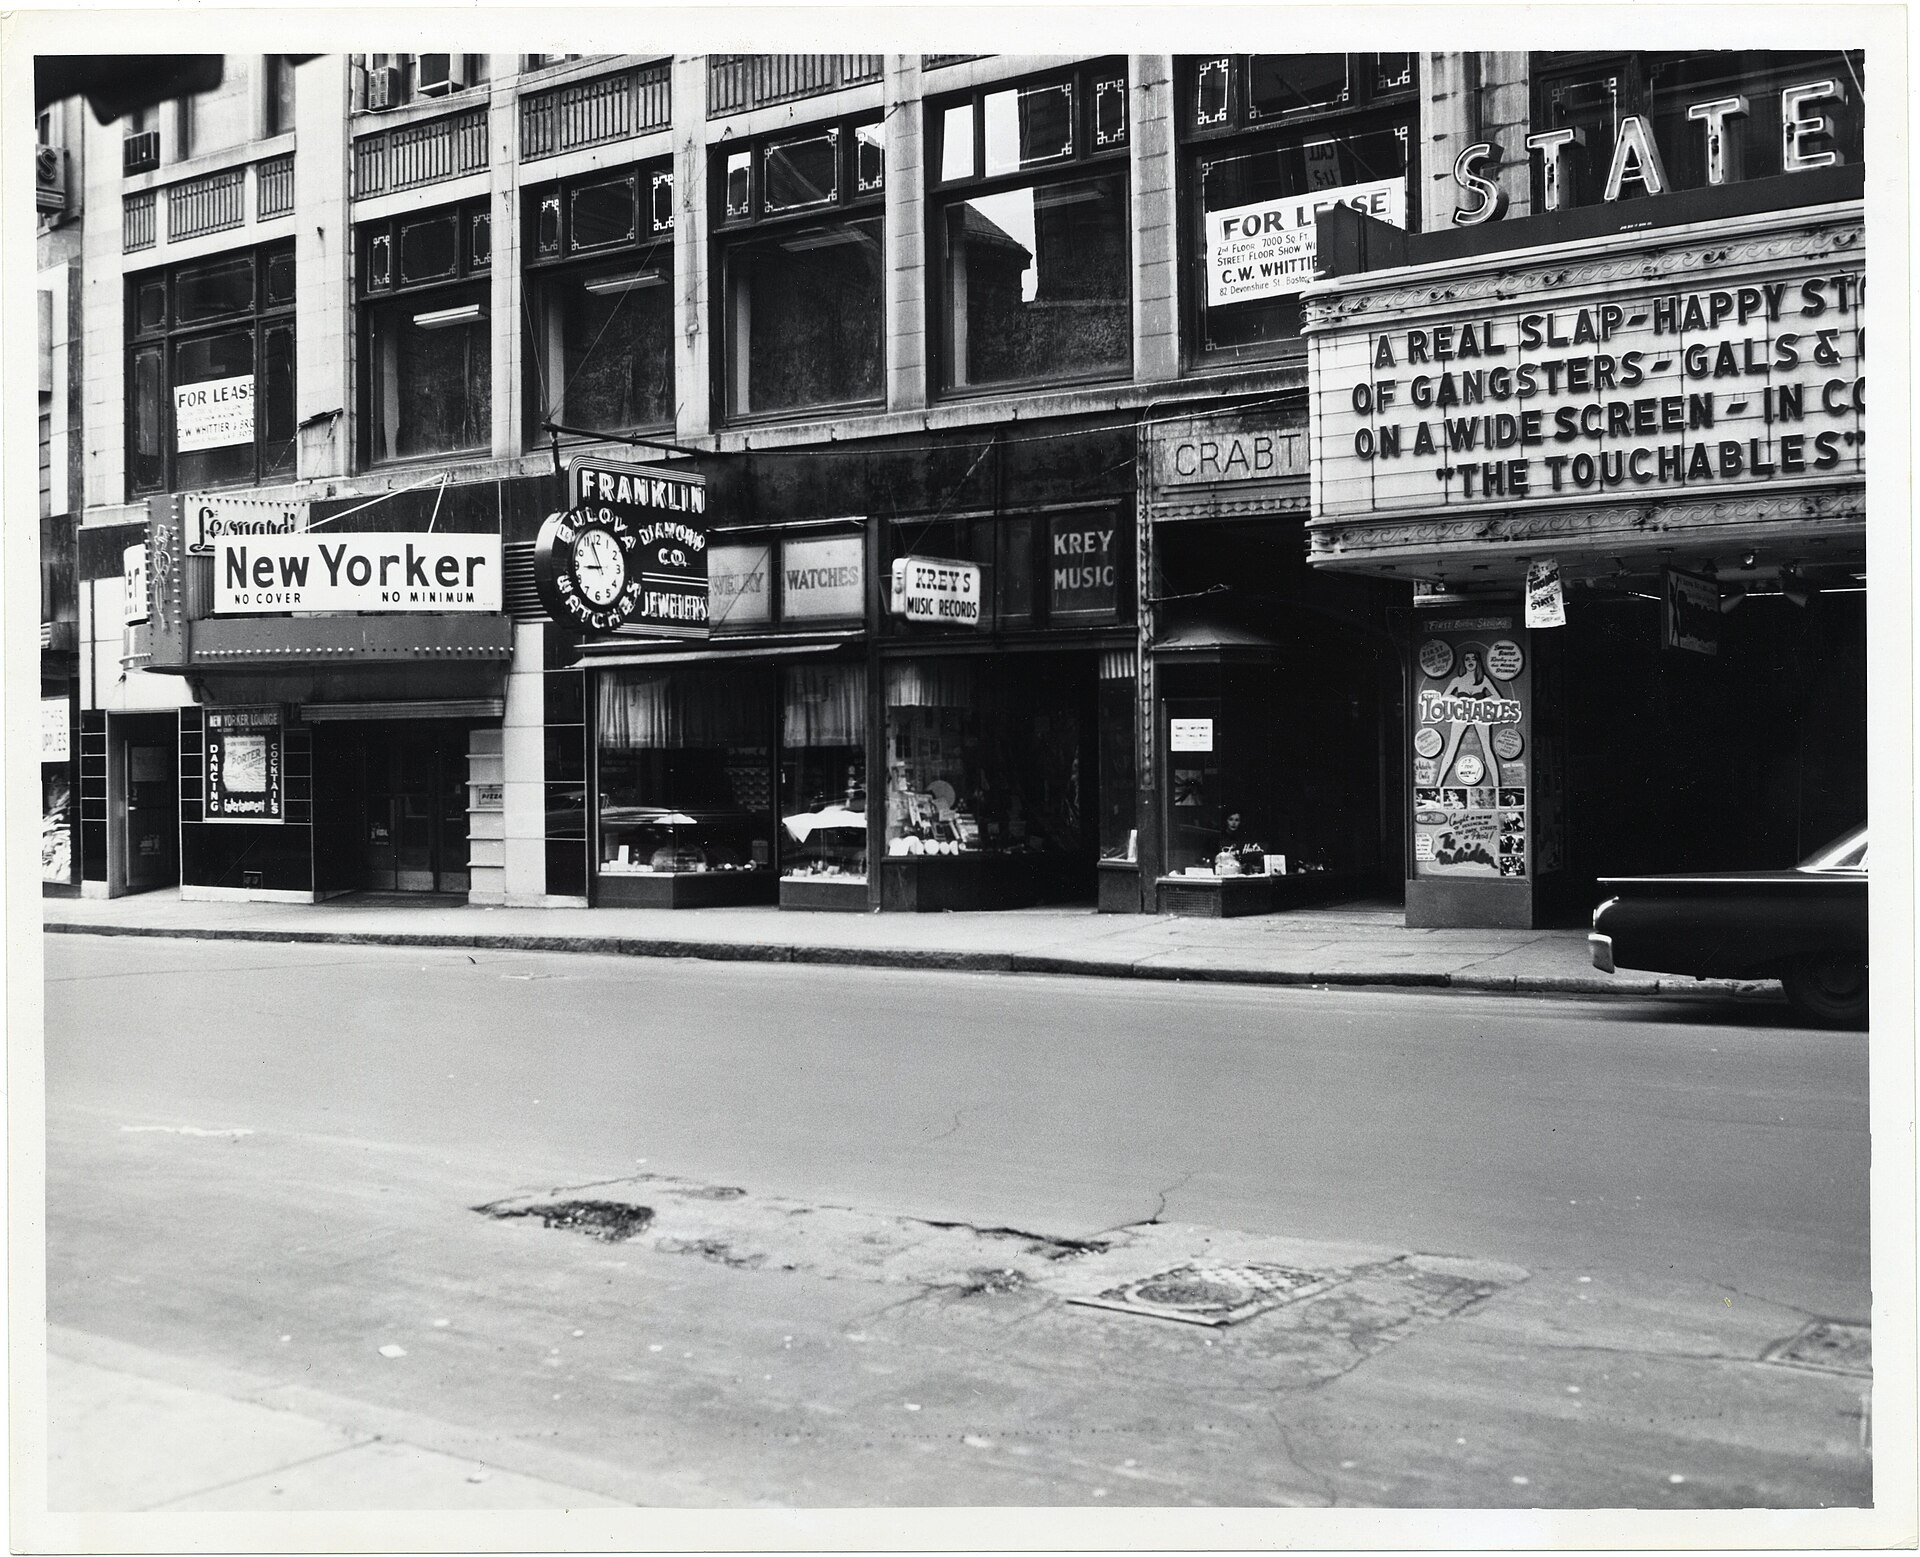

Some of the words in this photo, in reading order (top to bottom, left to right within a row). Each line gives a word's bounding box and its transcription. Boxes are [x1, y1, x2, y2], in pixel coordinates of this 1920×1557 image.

[1452, 79, 1844, 227] STATE
[1223, 211, 1284, 241] FOR
[1296, 192, 1387, 228] LSE
[1262, 236, 1283, 247] 7000
[1220, 288, 1228, 297] 82
[1230, 281, 1269, 295] Devonshire
[1222, 266, 1255, 284] C.W.
[1374, 333, 1396, 369] A
[1407, 320, 1506, 364] REAL
[1520, 282, 1786, 350] SLAP-HAPPY
[1800, 273, 1866, 318] ST
[1352, 379, 1397, 415] OF
[1411, 351, 1645, 410] GANGSTERS
[1684, 333, 1800, 379] GALS
[1813, 328, 1842, 367] &
[179, 391, 206, 408] FOR
[213, 383, 254, 403] LEASE
[1355, 423, 1400, 460] ON
[1413, 421, 1436, 456] A
[1445, 409, 1543, 452] WIDE
[1554, 392, 1714, 442] SCREEN
[1763, 382, 1804, 424] IN
[1176, 432, 1311, 476] CRABT
[581, 470, 705, 514] FRANKLIN
[639, 521, 706, 552] DIAMOND
[1053, 530, 1114, 555] KREY
[226, 546, 310, 589] New
[318, 543, 486, 588] Yorker
[786, 566, 858, 590] WATCHES
[1053, 566, 1114, 590] MUSIC
[235, 594, 249, 605] NO
[256, 593, 301, 605] COVER
[382, 591, 401, 602] NO
[410, 591, 475, 603] MINIMUM
[709, 571, 764, 597] WELRY
[641, 591, 709, 621] JEWELERS
[907, 597, 933, 615] MUSIC
[939, 599, 977, 618] RECORDS
[1419, 700, 1521, 723] TOUCHABLES
[210, 744, 219, 811] DANCING
[270, 743, 279, 814] COCKTAILS
